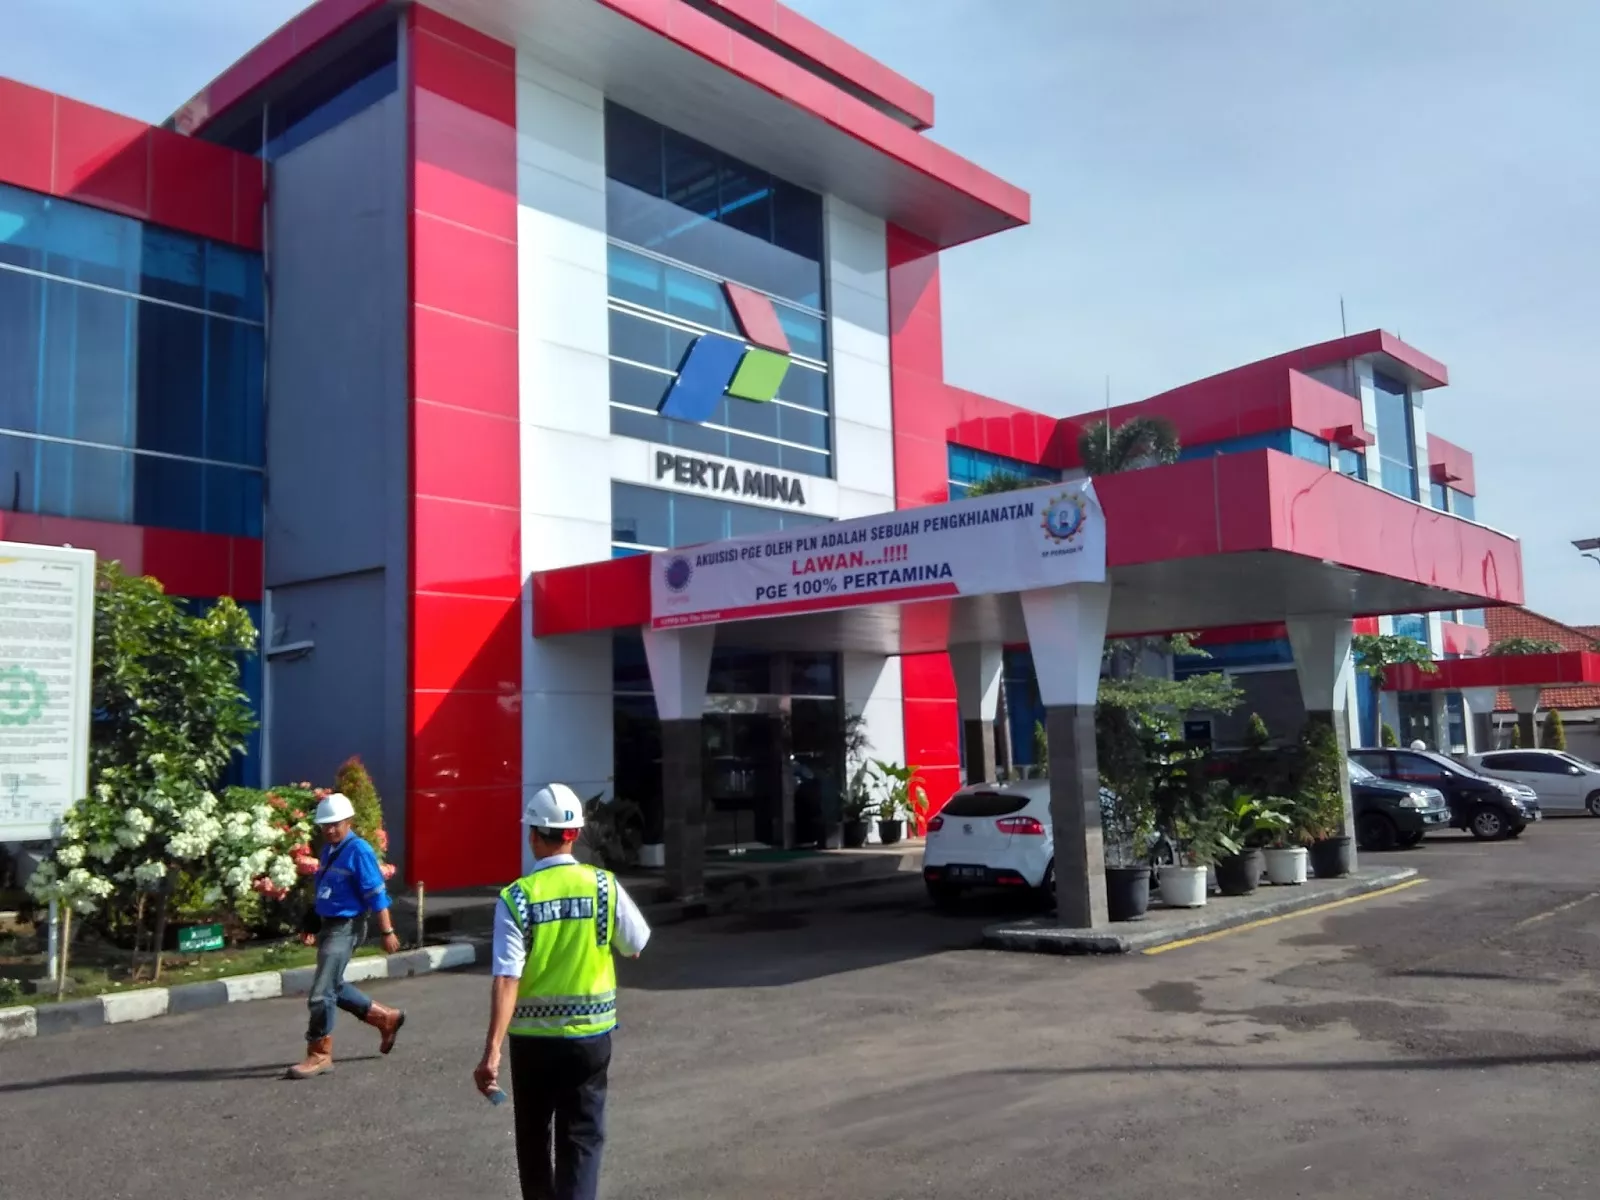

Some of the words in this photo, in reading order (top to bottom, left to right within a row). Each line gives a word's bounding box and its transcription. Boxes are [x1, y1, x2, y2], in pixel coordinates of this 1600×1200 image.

[656, 450, 806, 505] PERTAMINA
[695, 547, 738, 568] AKUISISI
[741, 545, 762, 561] PGE
[765, 541, 793, 557] OLEH
[796, 537, 818, 552] PLN
[821, 529, 867, 549] ADALAH
[871, 520, 920, 542] SEBUAH
[923, 502, 1035, 533] PENGKHIANATAN
[755, 583, 788, 601] PGE
[794, 577, 837, 596] 100%
[843, 562, 953, 590] PERTAMINA
[531, 898, 593, 923] SATPAM
